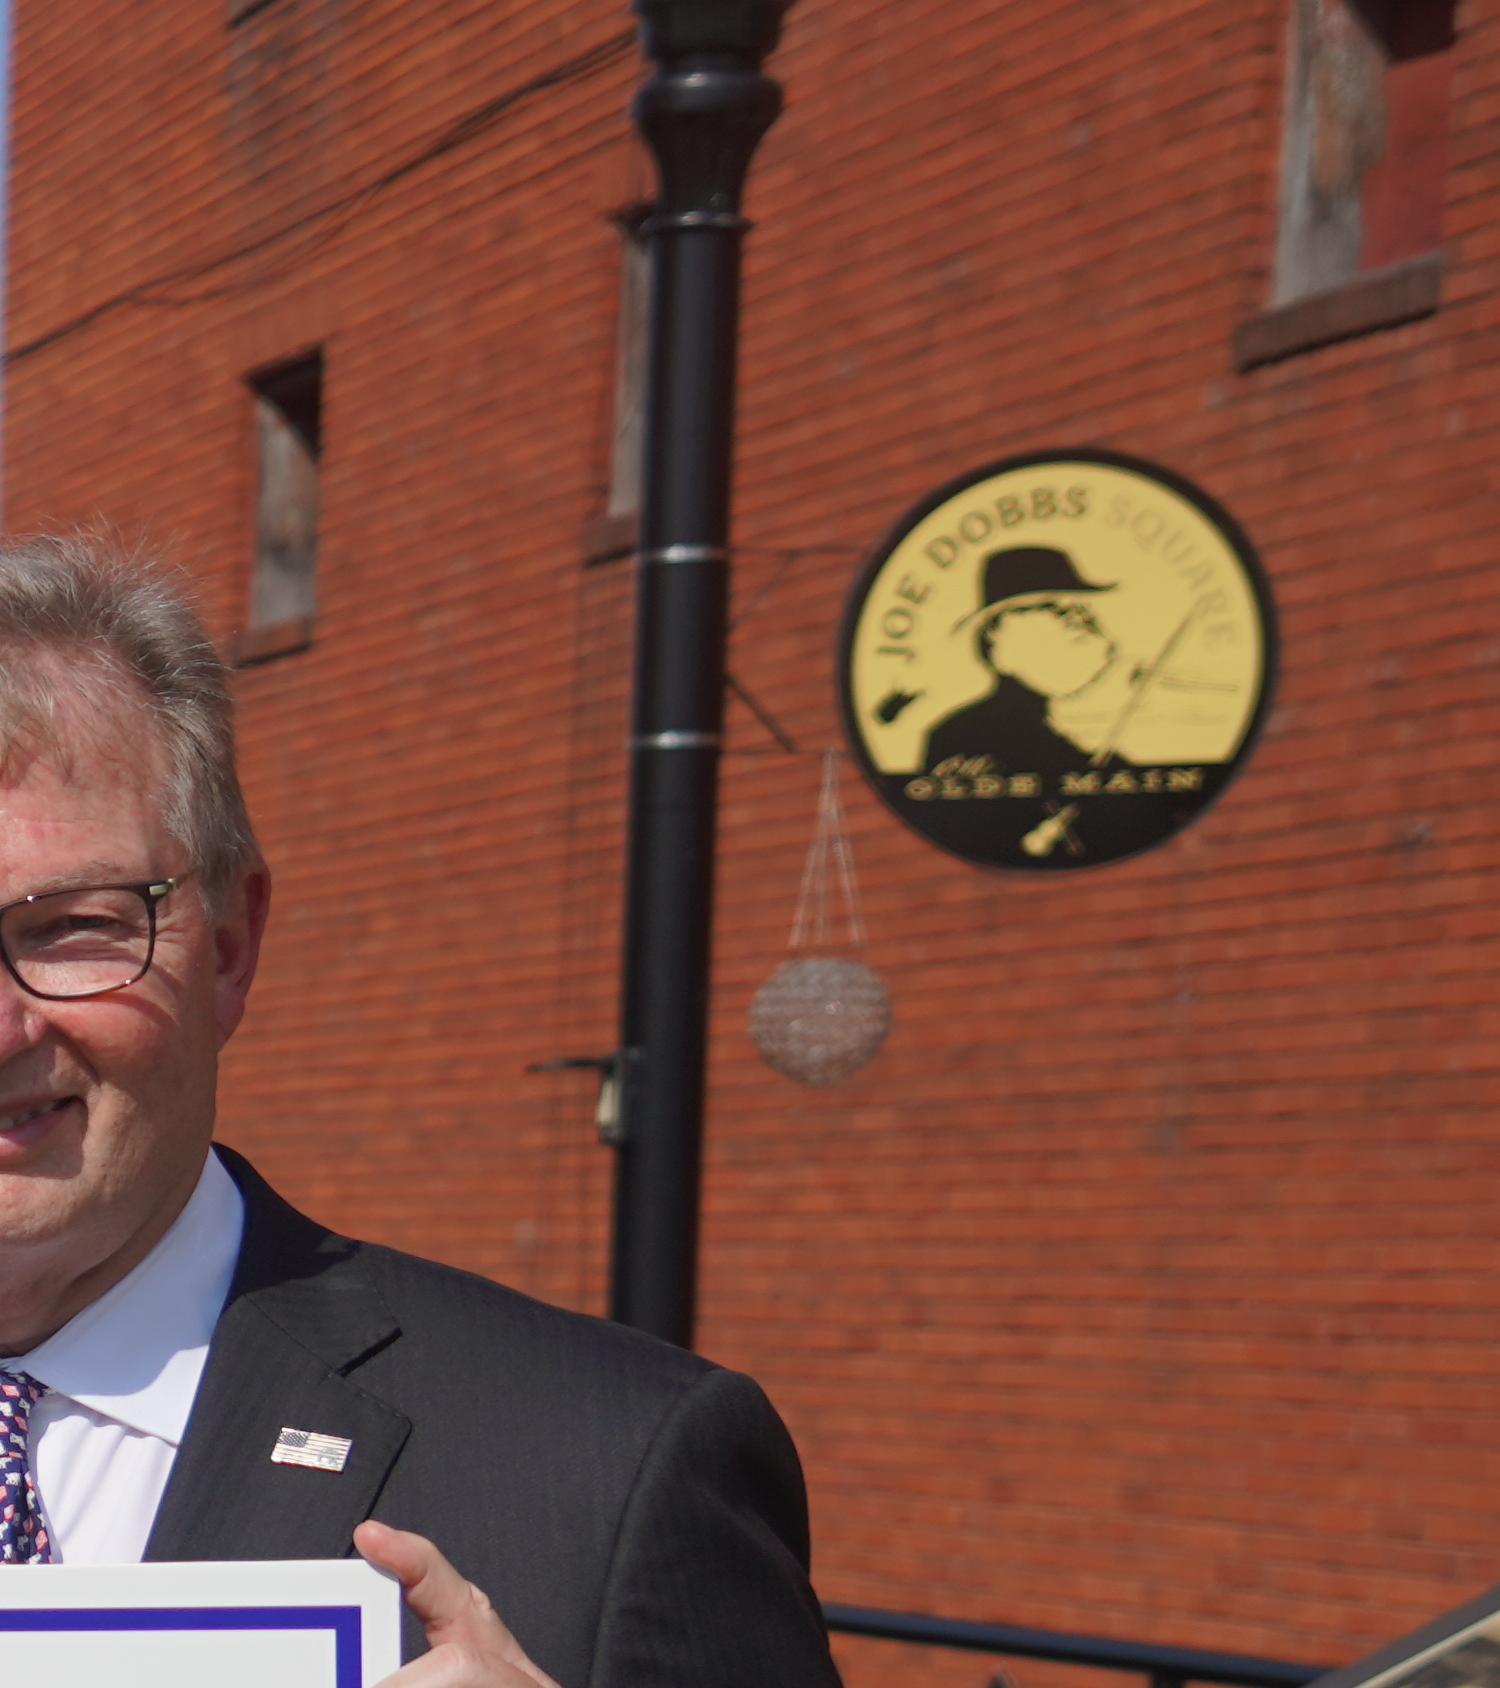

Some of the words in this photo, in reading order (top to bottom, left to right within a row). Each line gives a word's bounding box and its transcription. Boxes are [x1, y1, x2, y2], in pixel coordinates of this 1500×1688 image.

[875, 574, 932, 664] JOE
[923, 486, 1092, 570] DOBBS
[1102, 492, 1238, 650] SQUARE
[904, 773, 1041, 800] OLDE
[1060, 767, 1202, 796] MAIN
